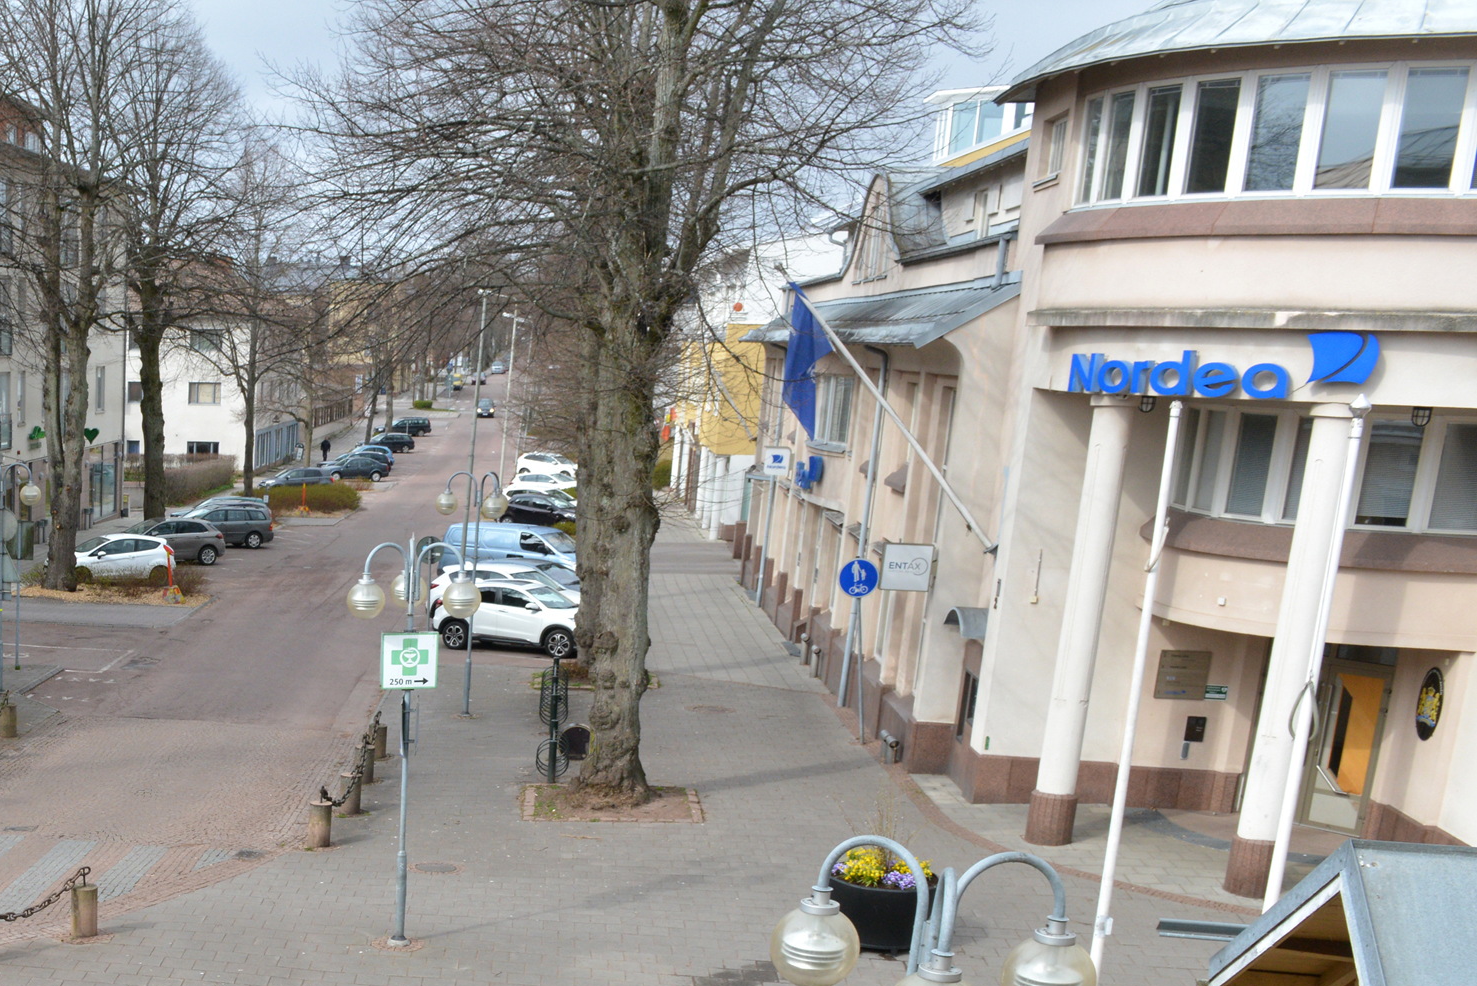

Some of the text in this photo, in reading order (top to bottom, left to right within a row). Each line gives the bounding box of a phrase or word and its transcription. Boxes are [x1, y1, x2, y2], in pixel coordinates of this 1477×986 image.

[1067, 349, 1292, 400] Nordea
[888, 561, 922, 571] ENTAX
[389, 678, 404, 686] 250
